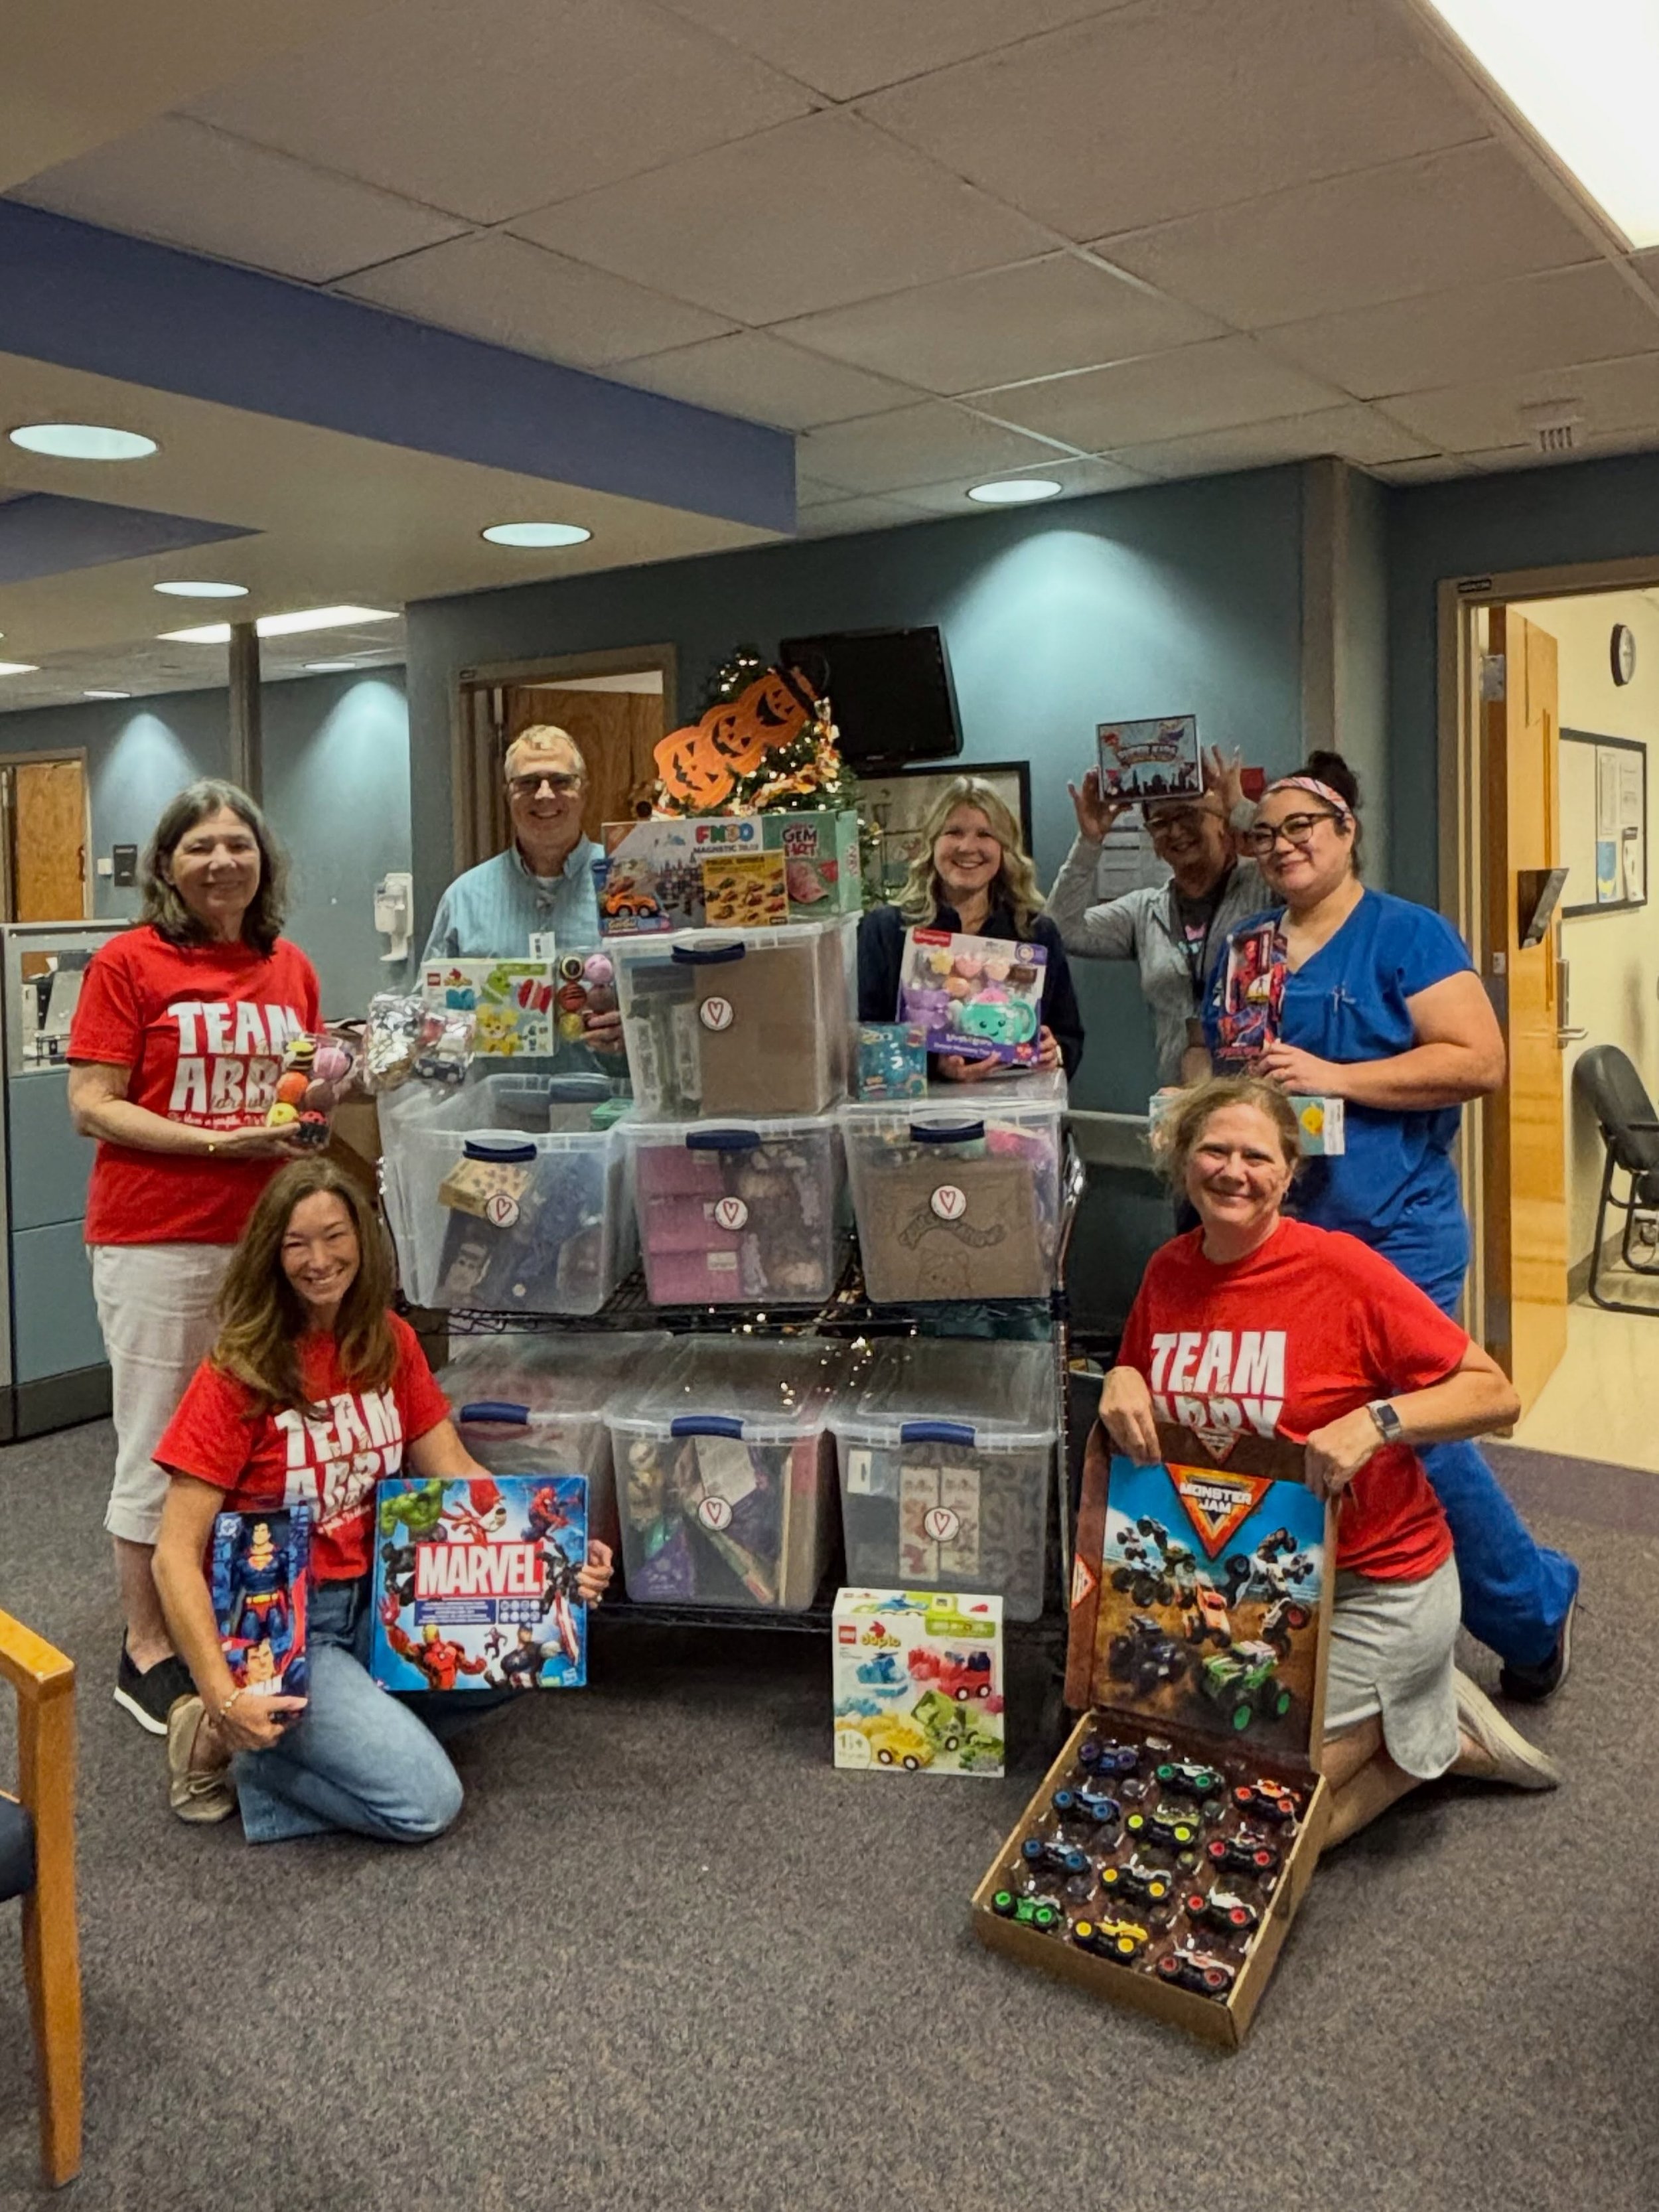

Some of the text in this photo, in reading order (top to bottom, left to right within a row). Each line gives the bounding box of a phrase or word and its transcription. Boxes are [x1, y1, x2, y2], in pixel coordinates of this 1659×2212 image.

[782, 828, 817, 843] GEM
[167, 1001, 303, 1055] TEAM
[169, 1057, 277, 1114] ABB
[1151, 1330, 1287, 1398] TEAM
[274, 1388, 402, 1467] TEAM
[1180, 1483, 1252, 1505] MONSTER
[1198, 1499, 1231, 1514] JAM
[418, 1544, 540, 1596] MARVEL
